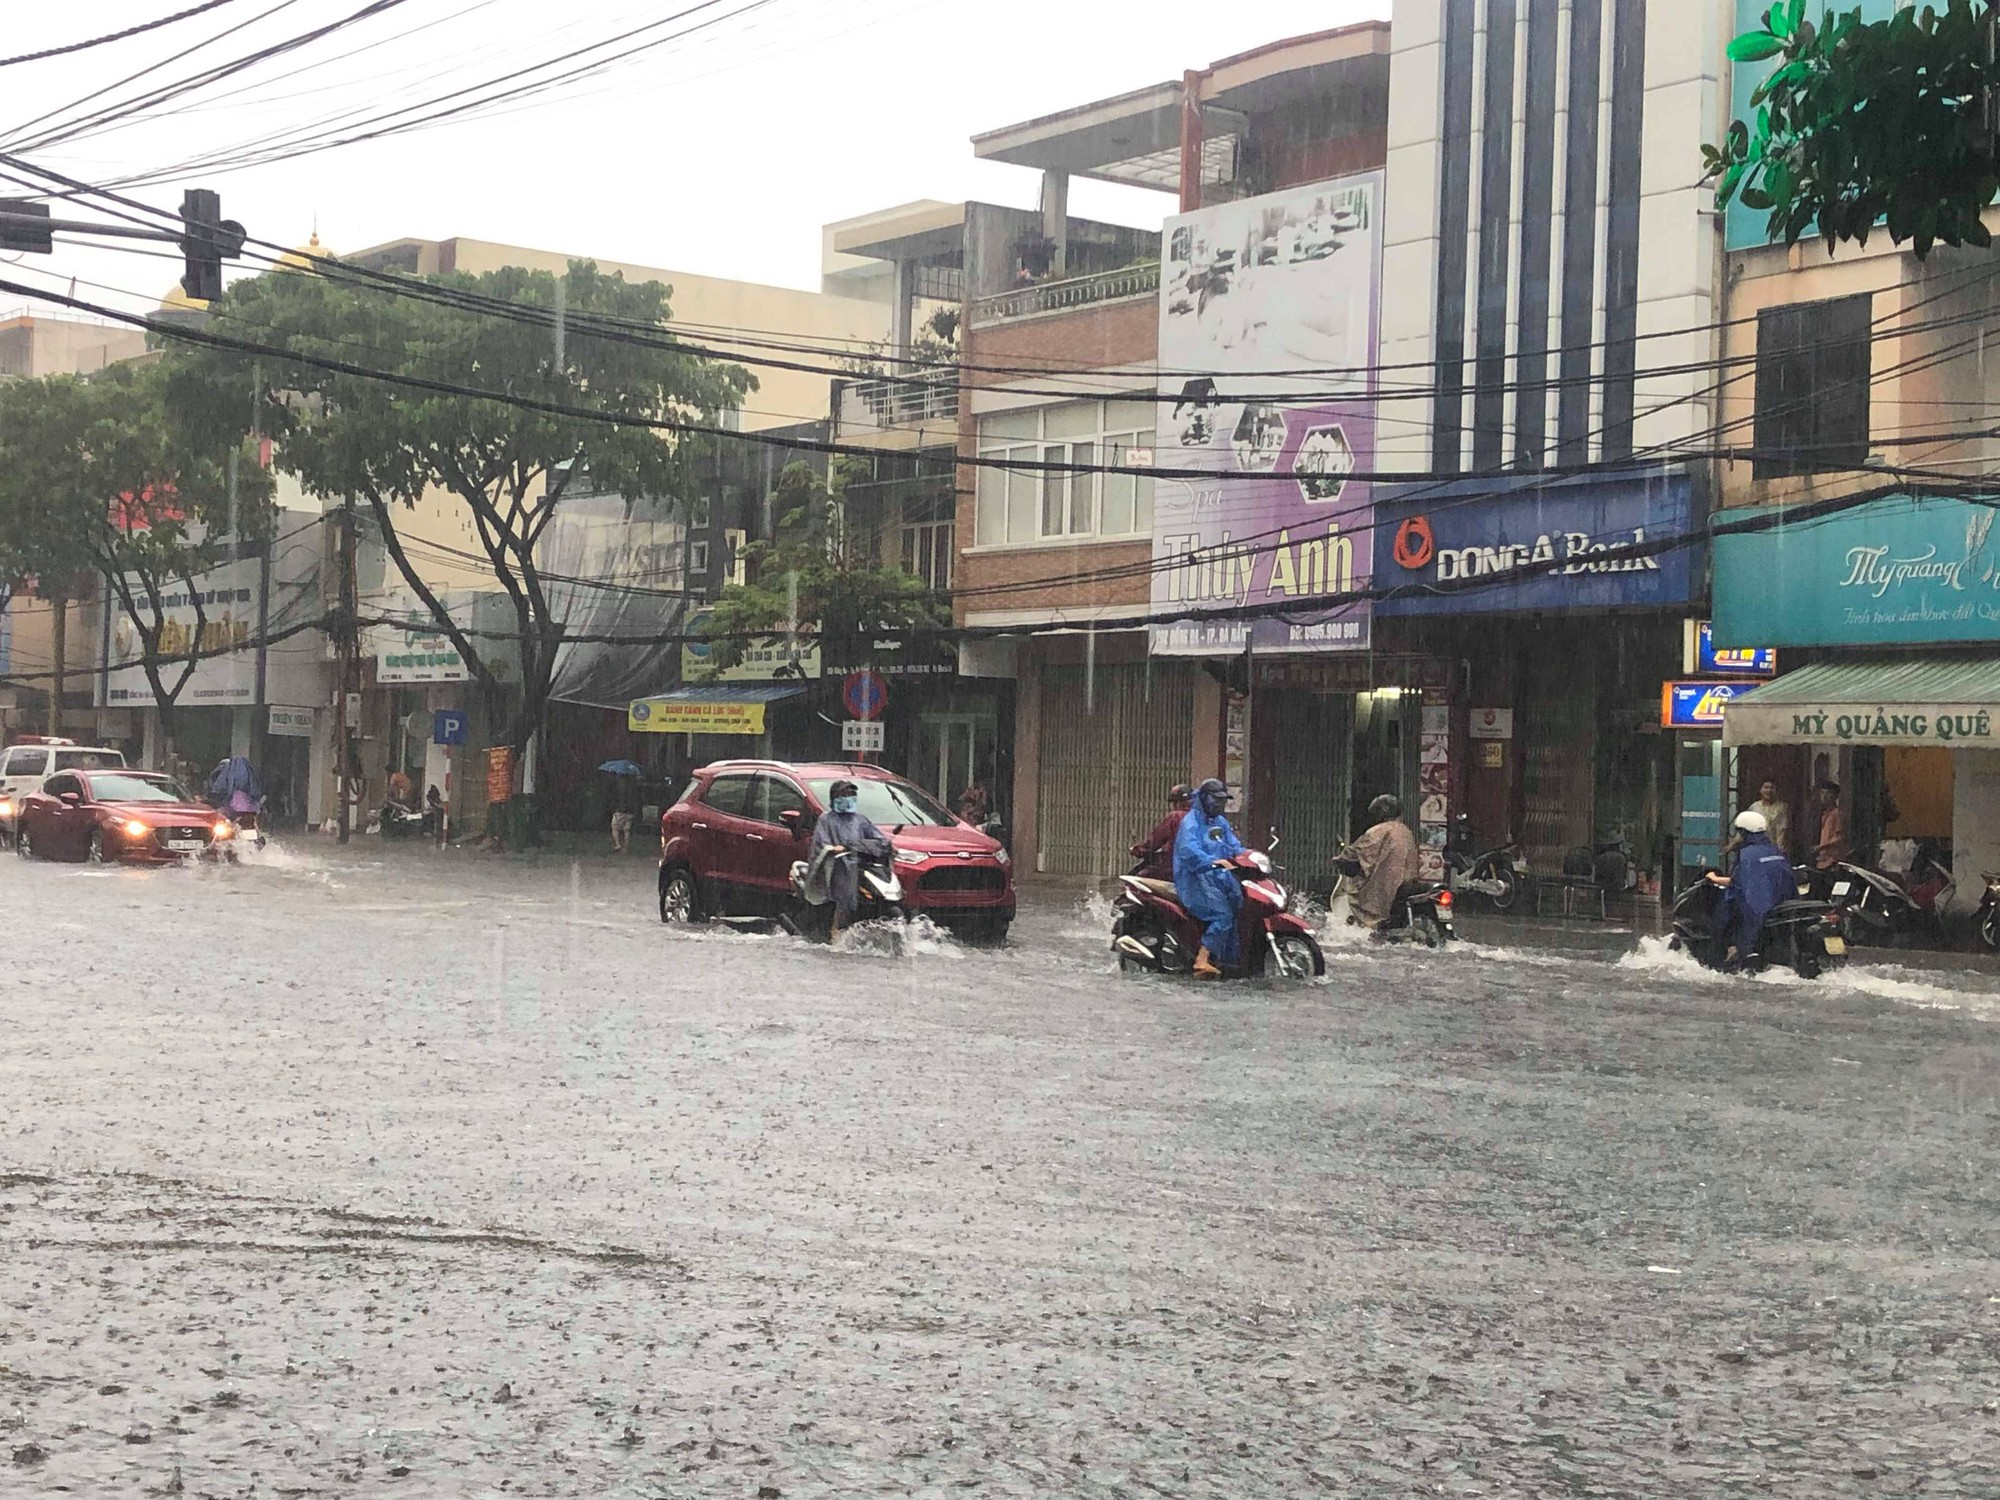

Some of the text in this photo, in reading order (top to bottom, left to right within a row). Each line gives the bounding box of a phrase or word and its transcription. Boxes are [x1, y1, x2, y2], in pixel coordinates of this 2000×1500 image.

[1167, 458, 1223, 523] Spa
[1264, 522, 1353, 597] Anh
[1561, 527, 1661, 576] Bank
[445, 719, 459, 737] P
[1835, 705, 1928, 740] QUẢNG
[1935, 709, 1991, 740] QUÊ
